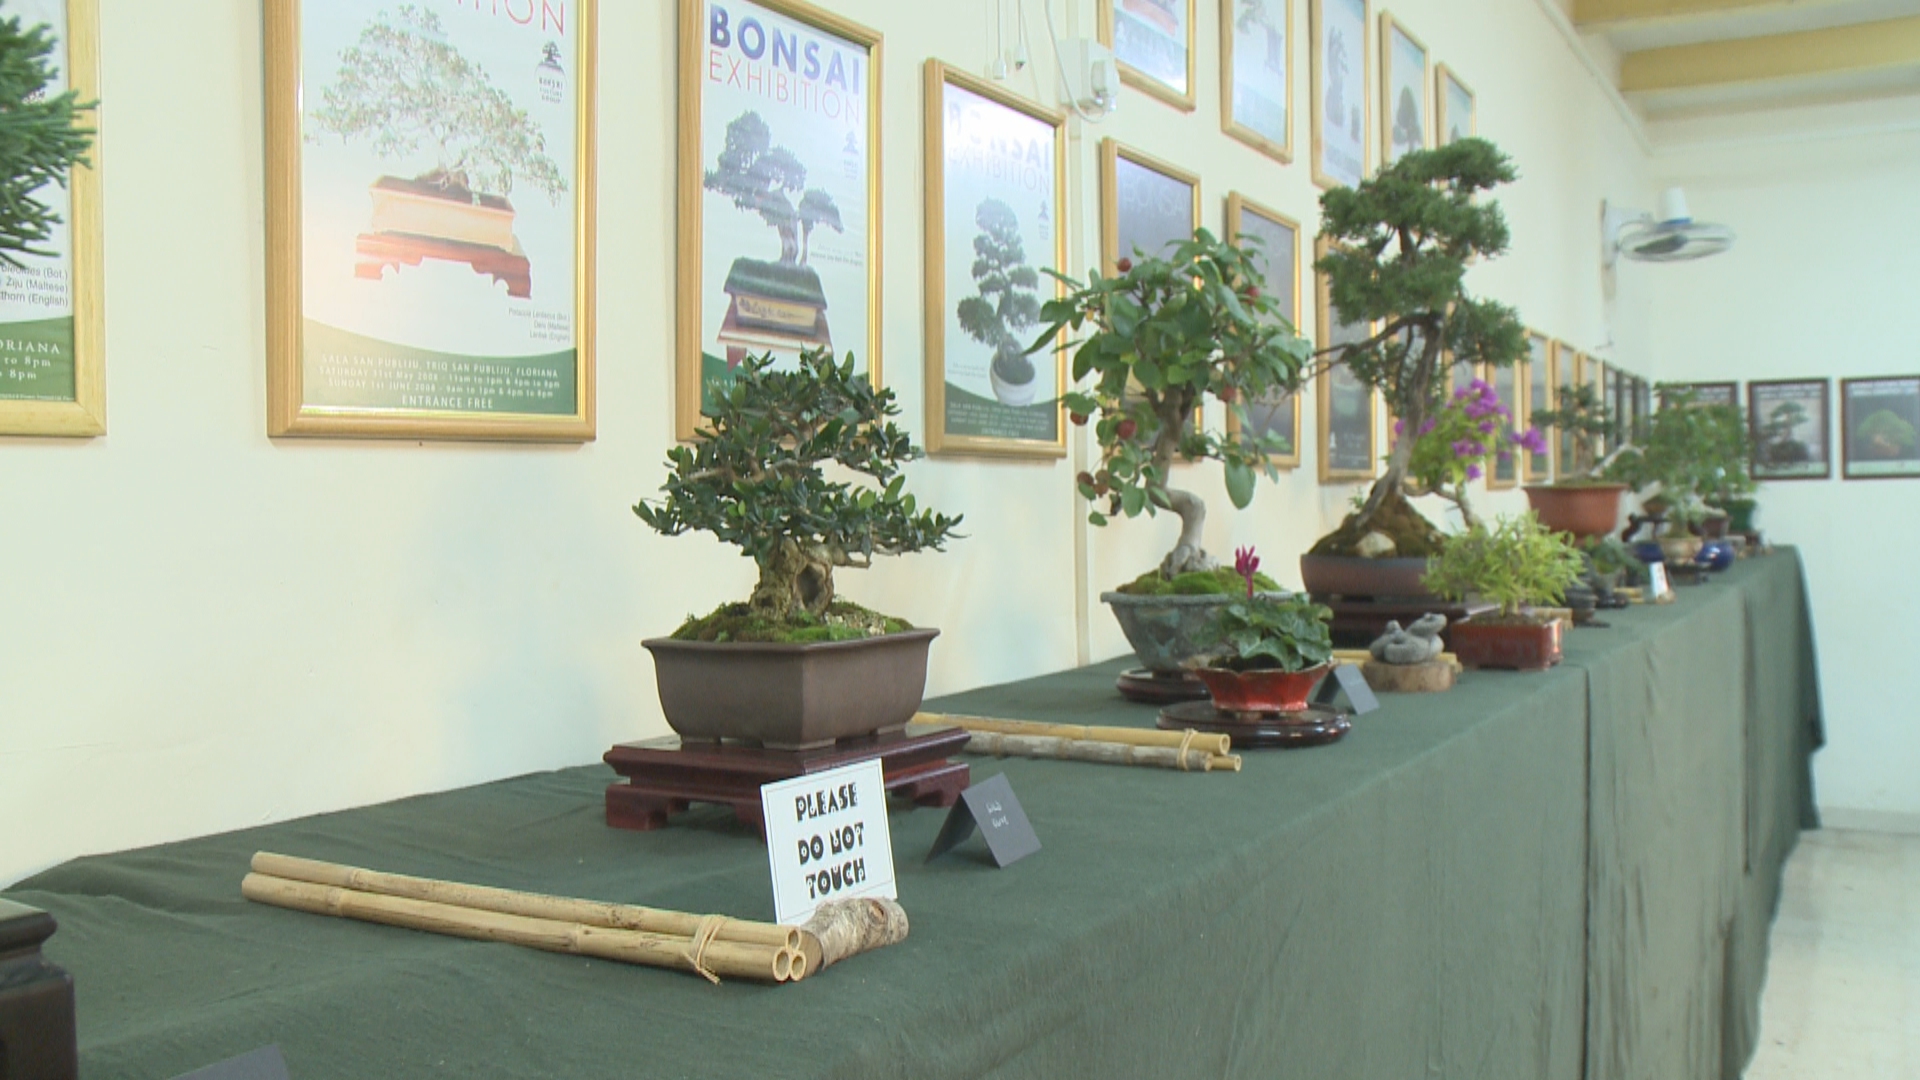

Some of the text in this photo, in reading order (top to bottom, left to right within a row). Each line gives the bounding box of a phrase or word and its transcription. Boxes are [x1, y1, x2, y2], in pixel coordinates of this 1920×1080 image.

[710, 3, 859, 95] BONSAI
[710, 49, 859, 125] EXHIBITION
[26, 279, 68, 293] (Maltese)
[28, 294, 68, 308] (English)
[4, 356, 51, 368] to 8pm
[353, 356, 373, 366] SAN
[452, 362, 470, 372] SAN
[516, 367, 558, 378] FLORIANA
[9, 369, 37, 381] 8pm
[320, 365, 368, 377] SATURDAY
[328, 377, 366, 389] SUNDAY
[401, 394, 494, 409] ENTRANCE FREE
[795, 782, 858, 822] PLEASE
[797, 821, 864, 866] DO NOT
[805, 857, 866, 899] TOUCH
